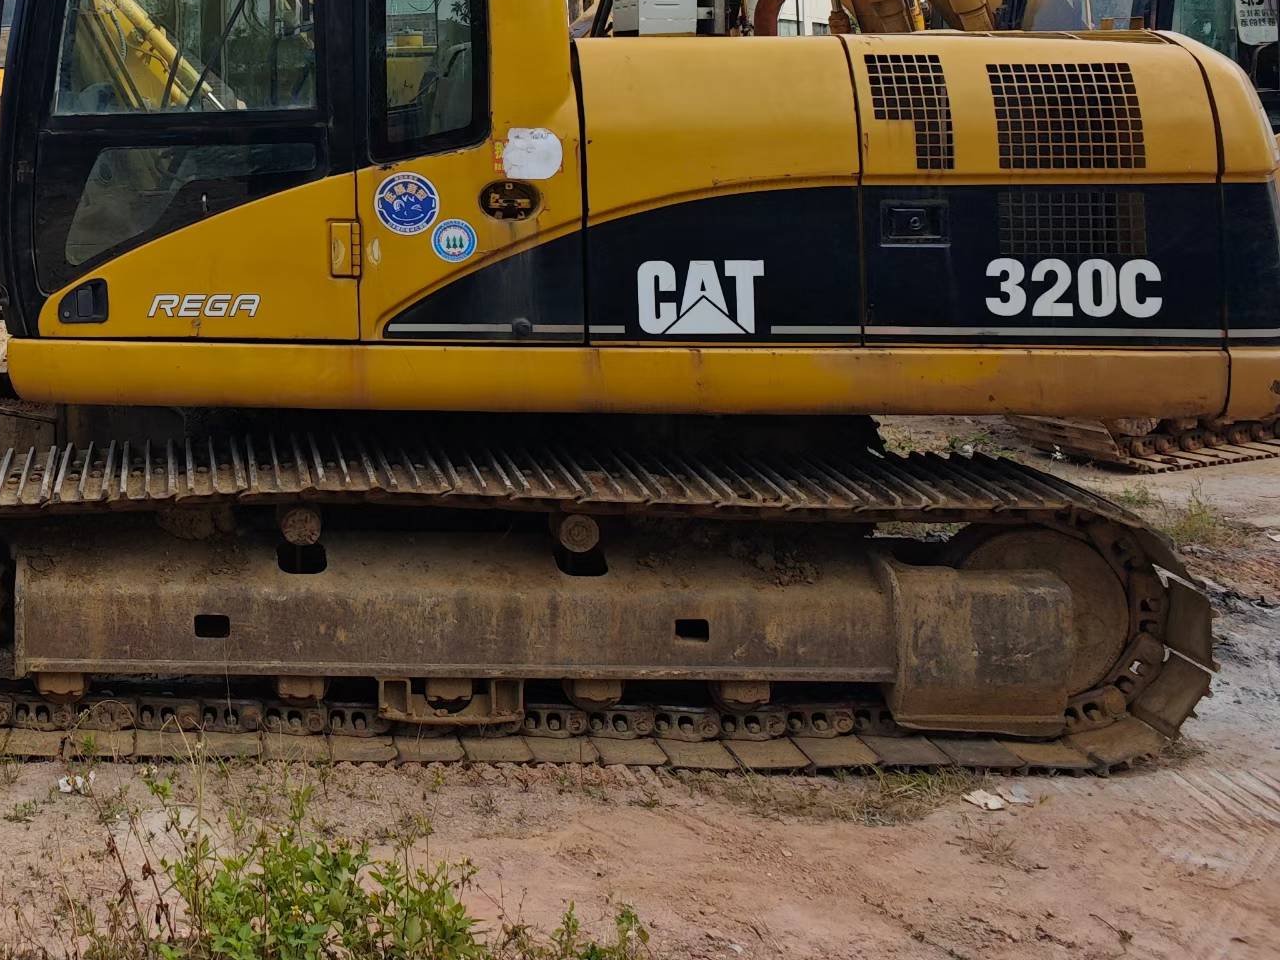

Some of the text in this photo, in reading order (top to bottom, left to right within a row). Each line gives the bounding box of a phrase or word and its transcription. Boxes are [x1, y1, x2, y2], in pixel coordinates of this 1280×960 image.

[148, 294, 261, 318] REGA
[637, 259, 765, 334] CAT
[985, 257, 1163, 318] 320C
